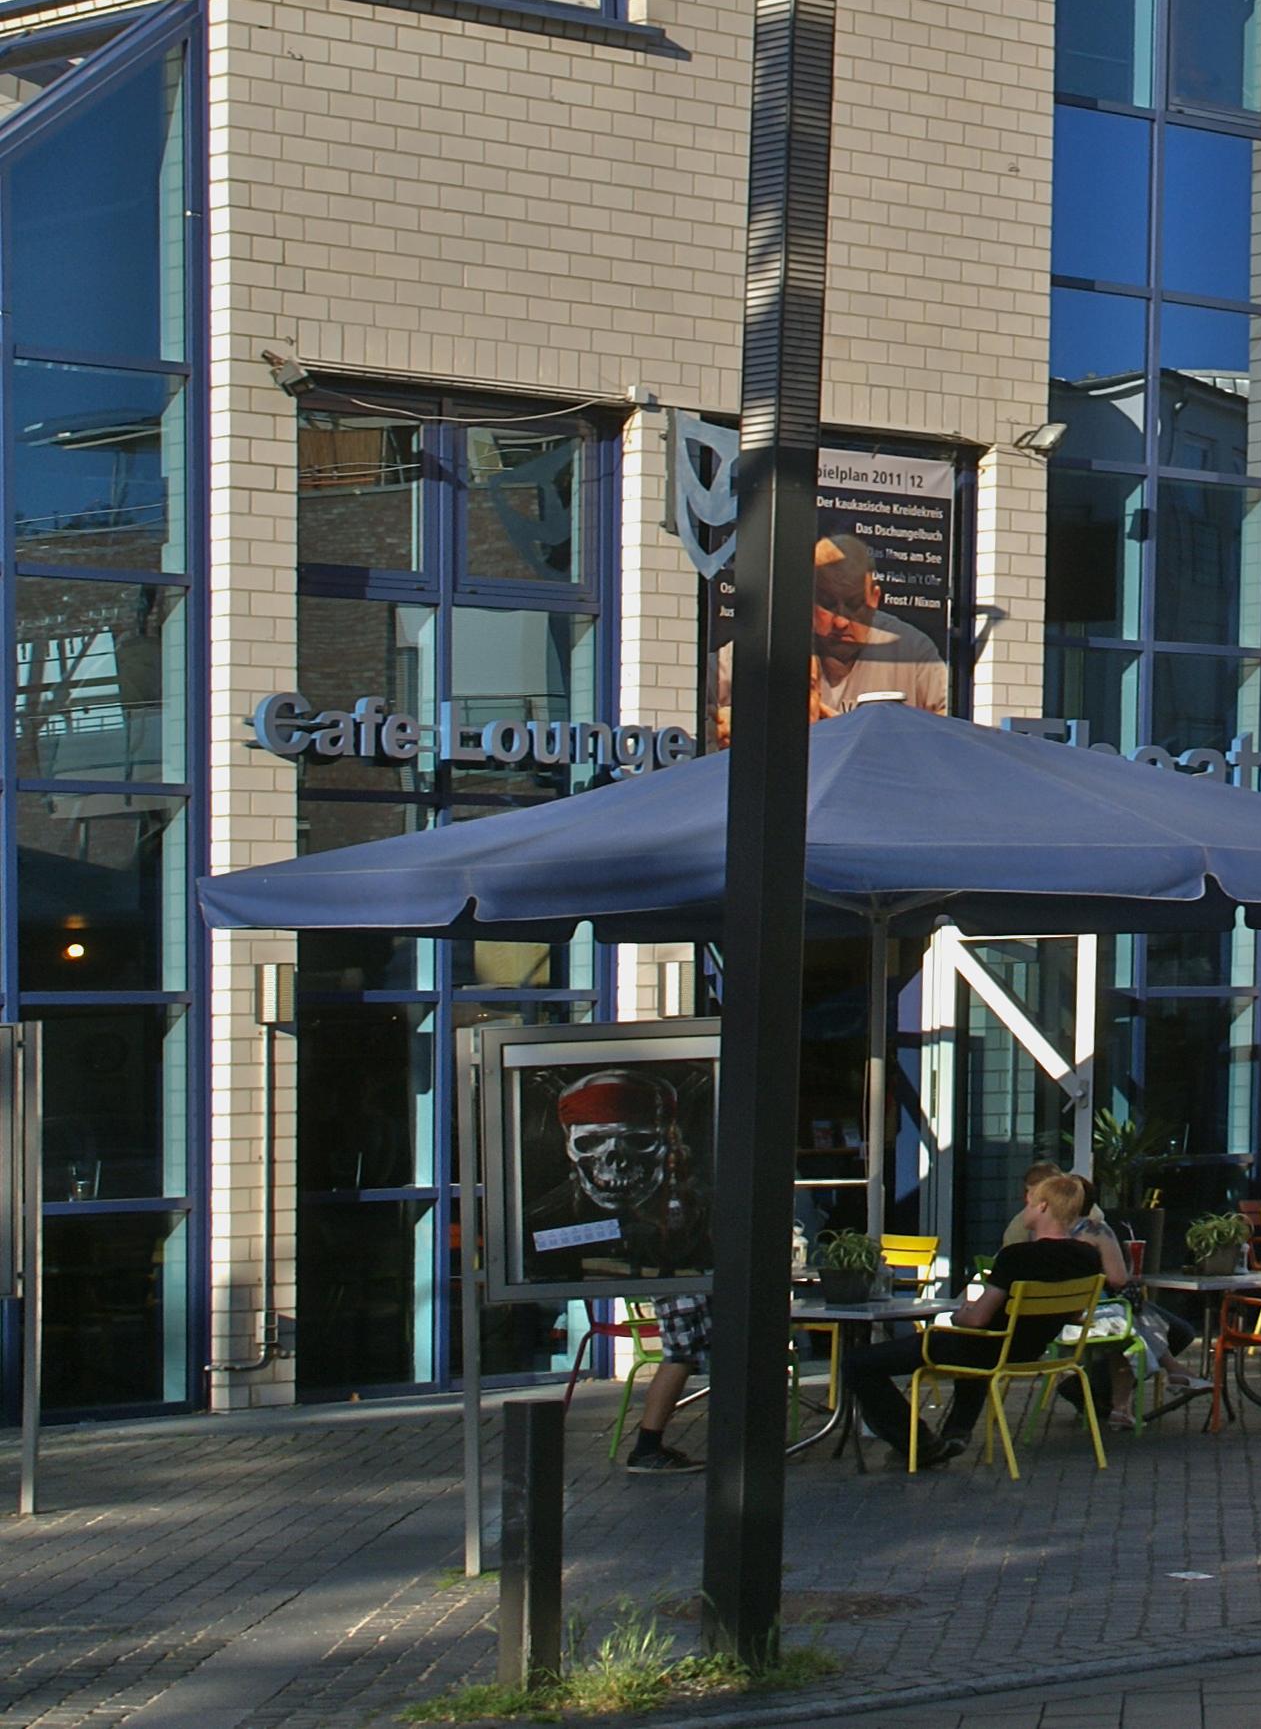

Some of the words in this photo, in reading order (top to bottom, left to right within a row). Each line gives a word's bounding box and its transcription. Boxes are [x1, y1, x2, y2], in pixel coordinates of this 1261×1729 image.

[816, 464, 869, 484] pielplan
[816, 495, 835, 507] Der
[835, 498, 891, 514] kaukasische
[892, 503, 944, 519] Kreidekreis
[855, 522, 874, 534] Das
[874, 524, 943, 541] Dschungelbuch
[925, 551, 942, 564] See
[884, 593, 908, 605] Frost
[914, 595, 941, 608] Nixon
[253, 691, 421, 759] Cafe
[440, 700, 696, 780] Lounge
